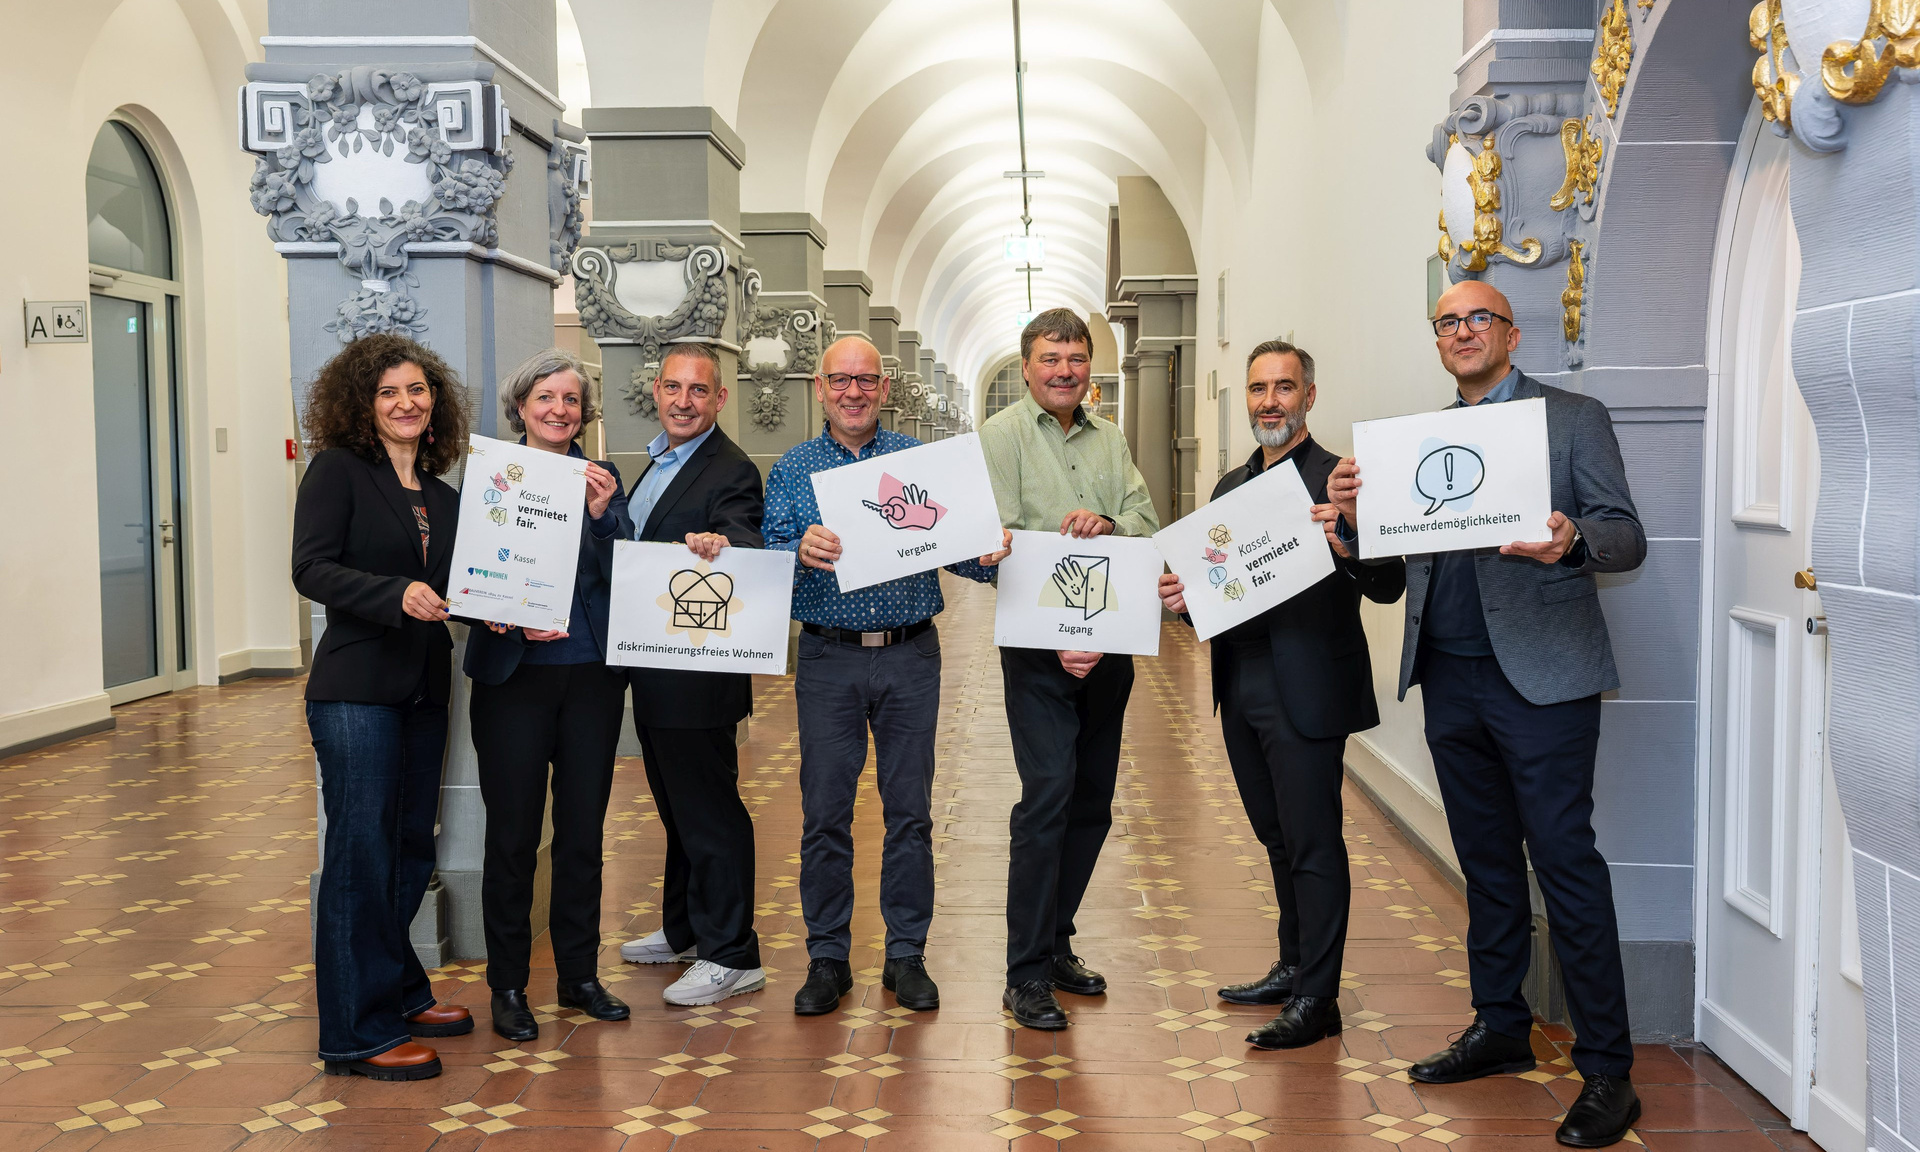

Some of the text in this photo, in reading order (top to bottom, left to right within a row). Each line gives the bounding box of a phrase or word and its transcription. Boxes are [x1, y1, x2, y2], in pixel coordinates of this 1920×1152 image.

[31, 316, 48, 338] A
[519, 489, 550, 505] Kassel
[517, 505, 568, 522] vermietet
[516, 516, 537, 530] fair.
[1380, 513, 1521, 535] Beschwerdemöglichkeiten
[897, 542, 938, 558] Vergabe
[1237, 530, 1272, 557] Kassel
[513, 553, 537, 565] Kassel
[1245, 536, 1300, 572] vermietet
[1251, 570, 1276, 588] fair.
[1058, 623, 1093, 636] Zugang
[617, 641, 774, 660] diskriminierungsfreies Wohnen
